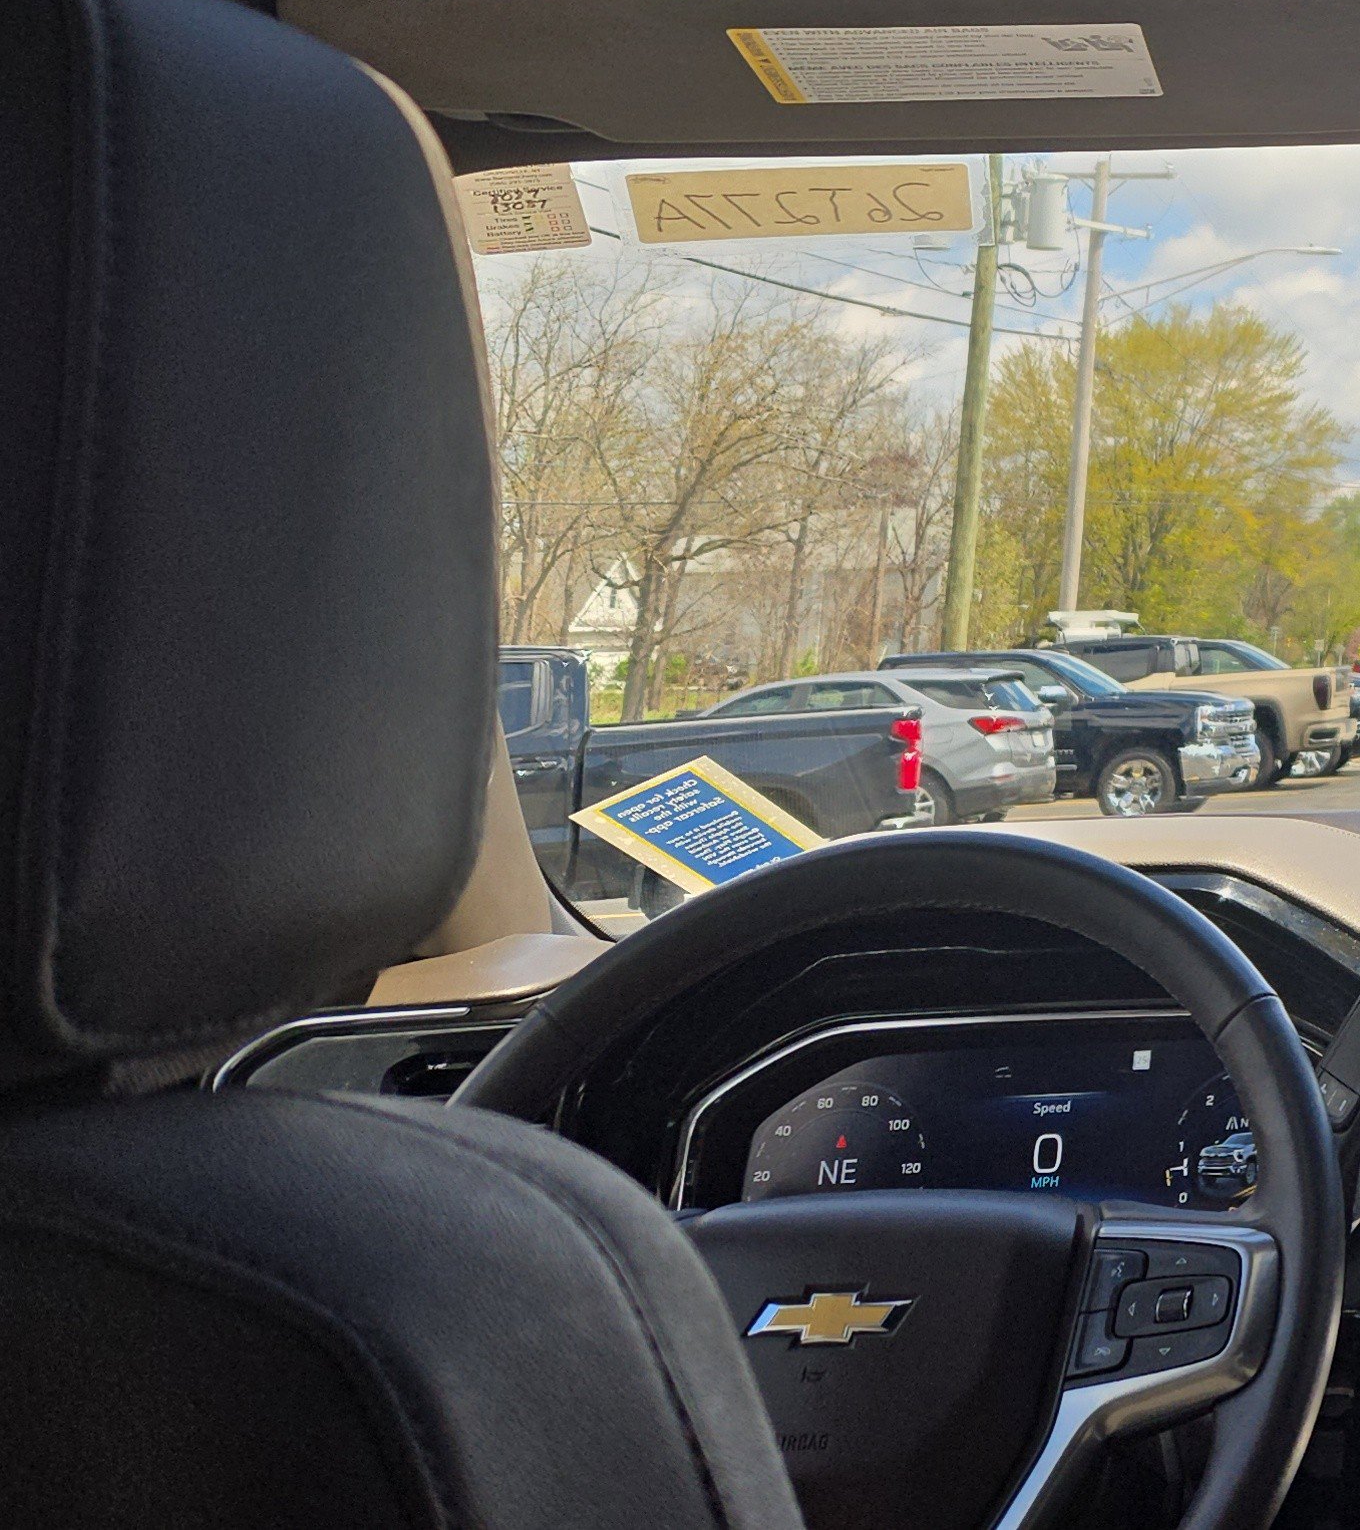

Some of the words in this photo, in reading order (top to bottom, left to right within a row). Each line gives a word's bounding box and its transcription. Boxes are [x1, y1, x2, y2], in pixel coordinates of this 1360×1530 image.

[817, 1098, 834, 1109] 60
[861, 1095, 879, 1107] 80
[1205, 1095, 1215, 1106] 2
[1033, 1101, 1071, 1117] Speed
[774, 1125, 792, 1137] 40
[888, 1119, 910, 1131] 100
[1178, 1141, 1185, 1152] 1
[1033, 1133, 1062, 1173] 0
[817, 1158, 858, 1185] NE
[901, 1163, 922, 1174] 120
[753, 1171, 770, 1182] 20
[1031, 1176, 1060, 1188] MPH
[1178, 1192, 1188, 1203] 0
